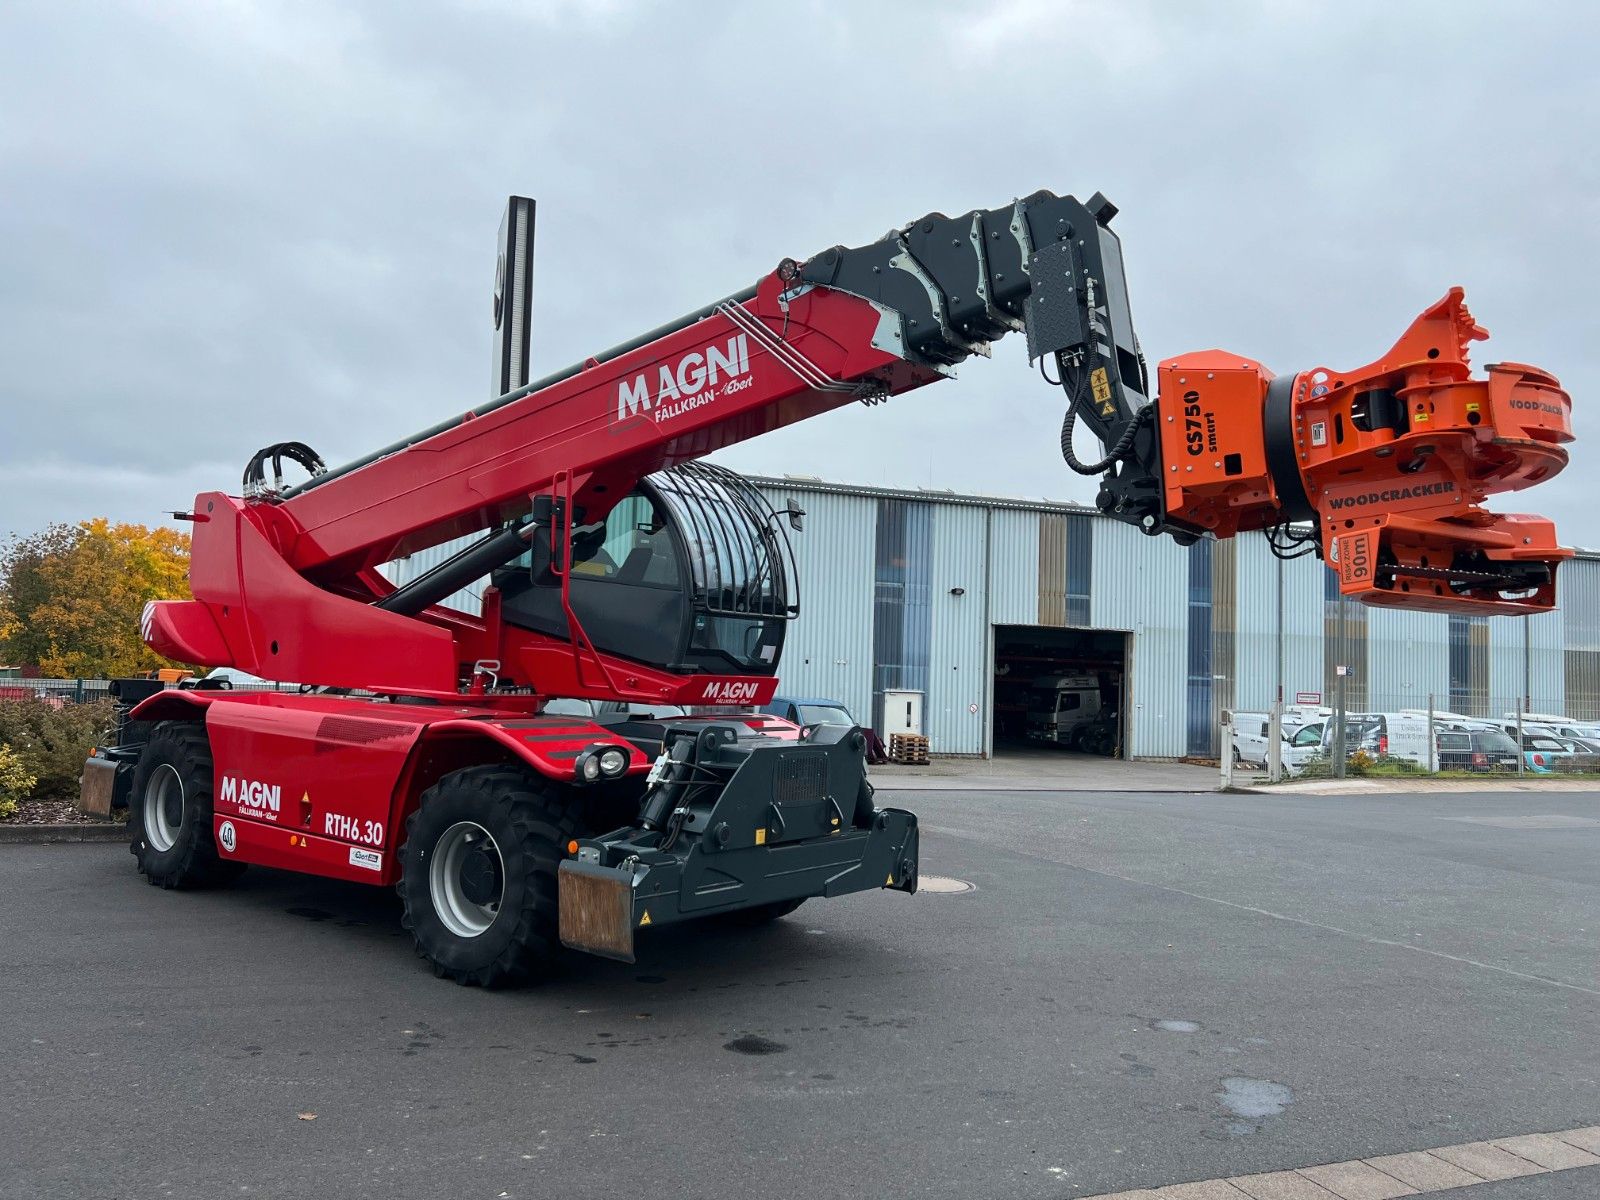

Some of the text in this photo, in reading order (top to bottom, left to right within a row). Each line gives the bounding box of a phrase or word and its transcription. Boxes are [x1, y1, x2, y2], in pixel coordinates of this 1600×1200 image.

[618, 333, 749, 420] MAGNI
[1183, 390, 1204, 456] CS750
[1204, 412, 1218, 453] smart
[1329, 481, 1455, 510] WOODCRACKER
[1343, 539, 1352, 581] RISK ZONE
[1353, 537, 1368, 578] 90m
[702, 682, 759, 698] MAGNI
[221, 776, 281, 811] MAGNI
[222, 826, 233, 846] 40
[325, 812, 383, 846] RTH6.30
